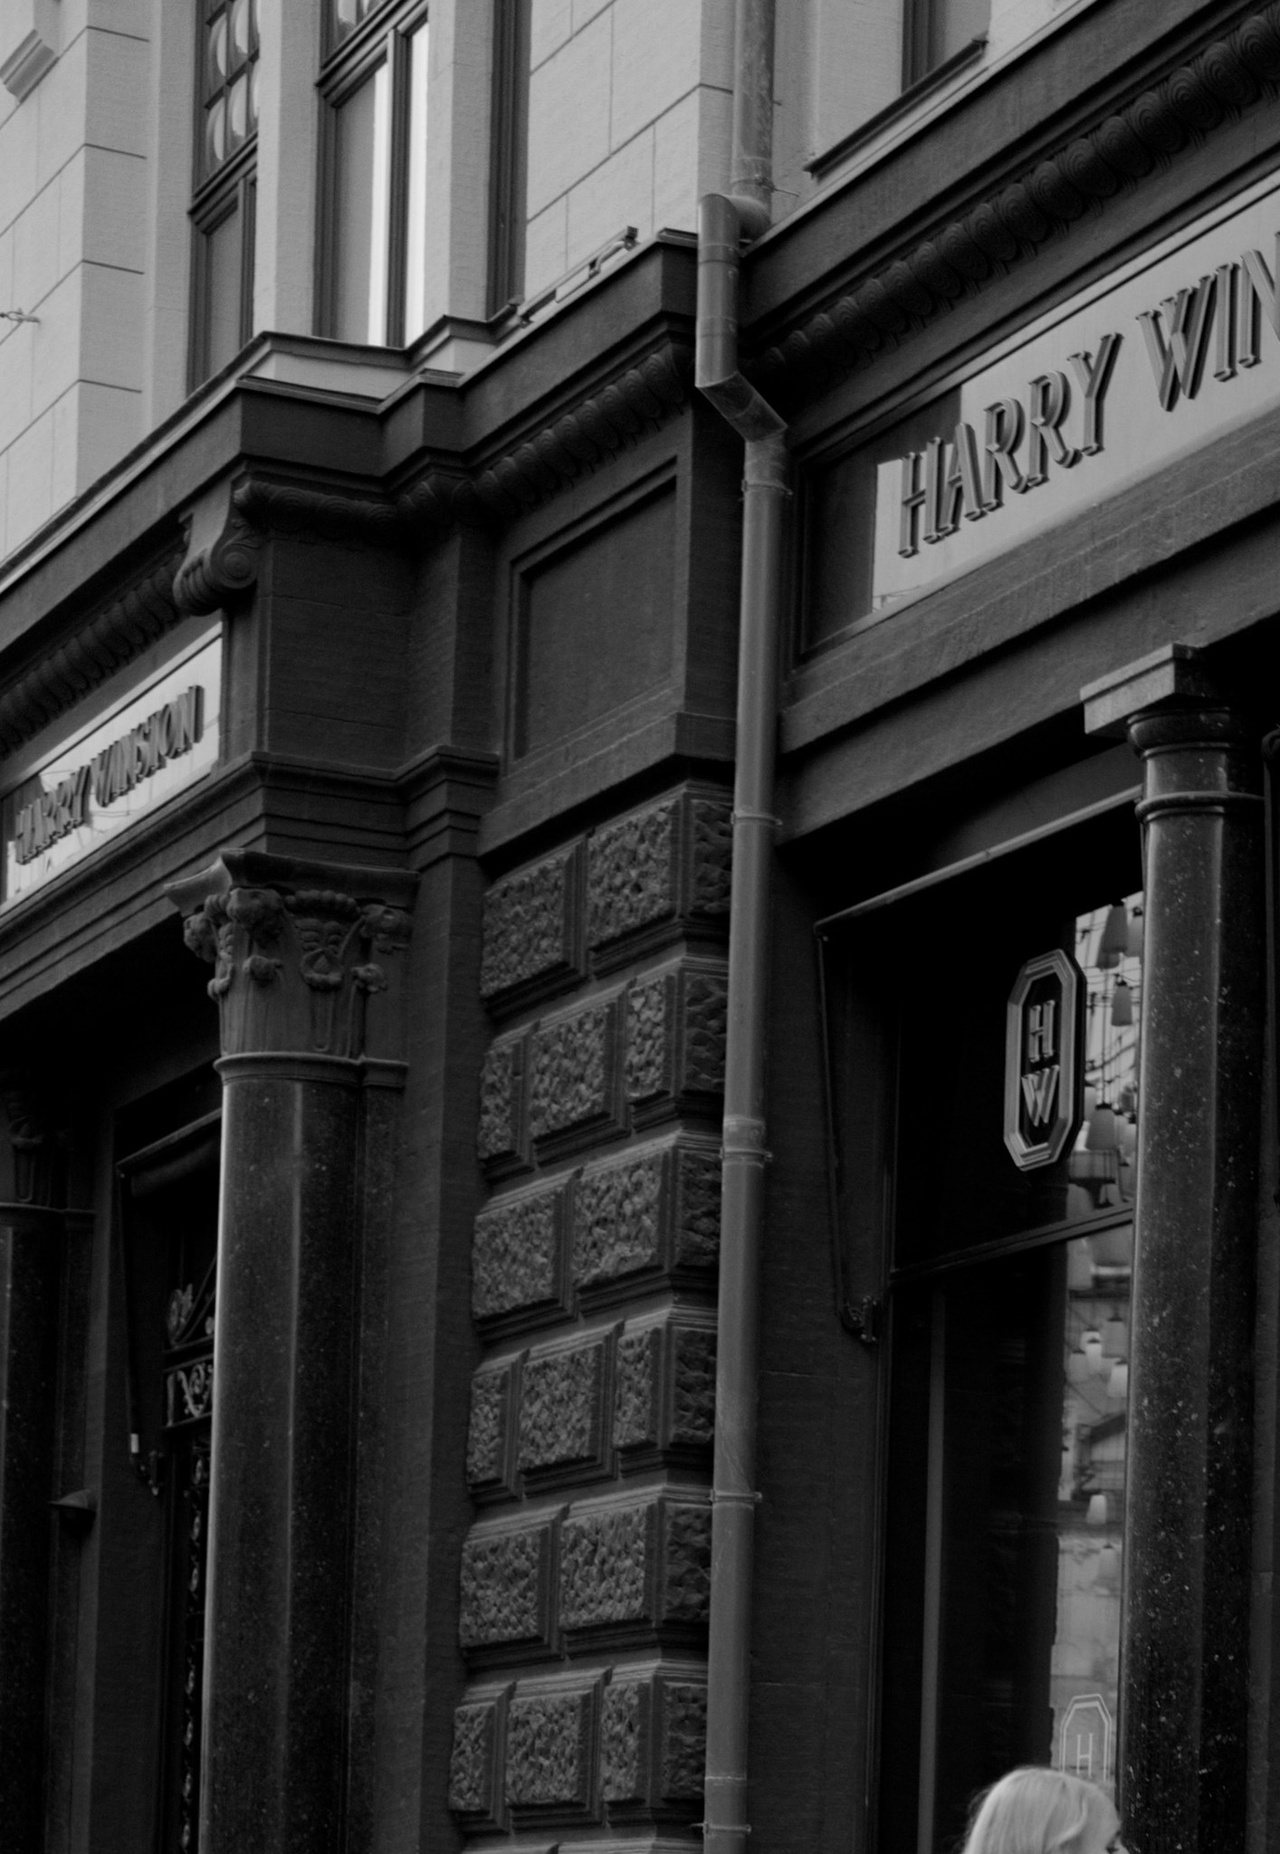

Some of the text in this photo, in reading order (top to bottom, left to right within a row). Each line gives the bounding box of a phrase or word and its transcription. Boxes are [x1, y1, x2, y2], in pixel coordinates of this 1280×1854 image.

[896, 332, 1124, 559] HARRY
[15, 684, 205, 866] HARRY WINSTON
